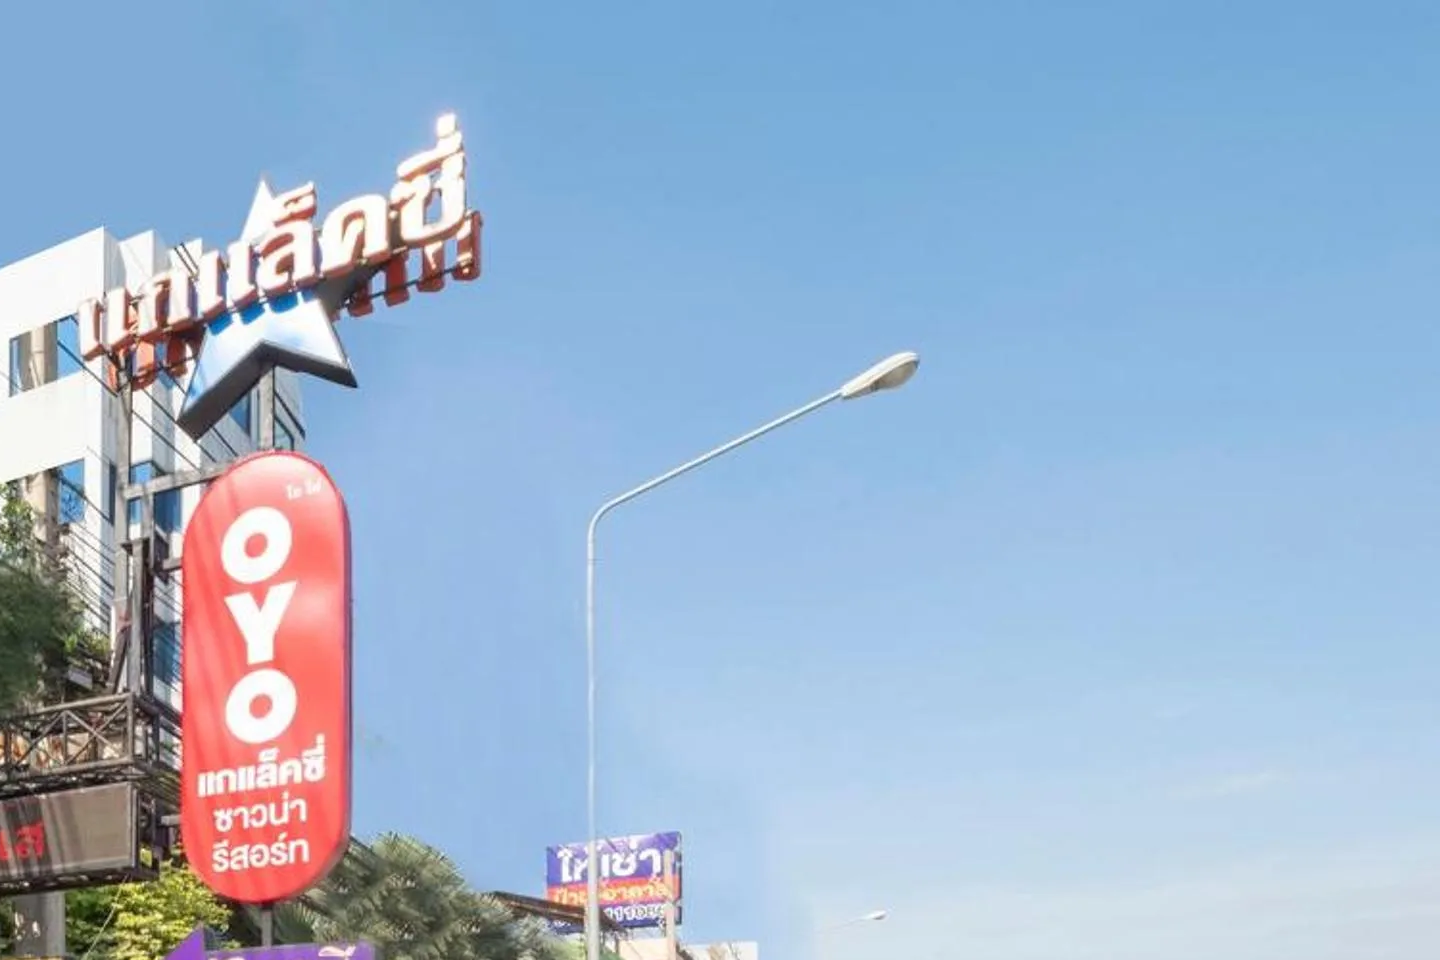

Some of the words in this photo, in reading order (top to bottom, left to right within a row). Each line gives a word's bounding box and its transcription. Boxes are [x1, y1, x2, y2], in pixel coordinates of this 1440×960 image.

[220, 505, 298, 744] OYO
[197, 734, 326, 798] แกแล็คซี่
[213, 791, 308, 834] ซาวน่า
[211, 836, 310, 873] รีสอร์ท
